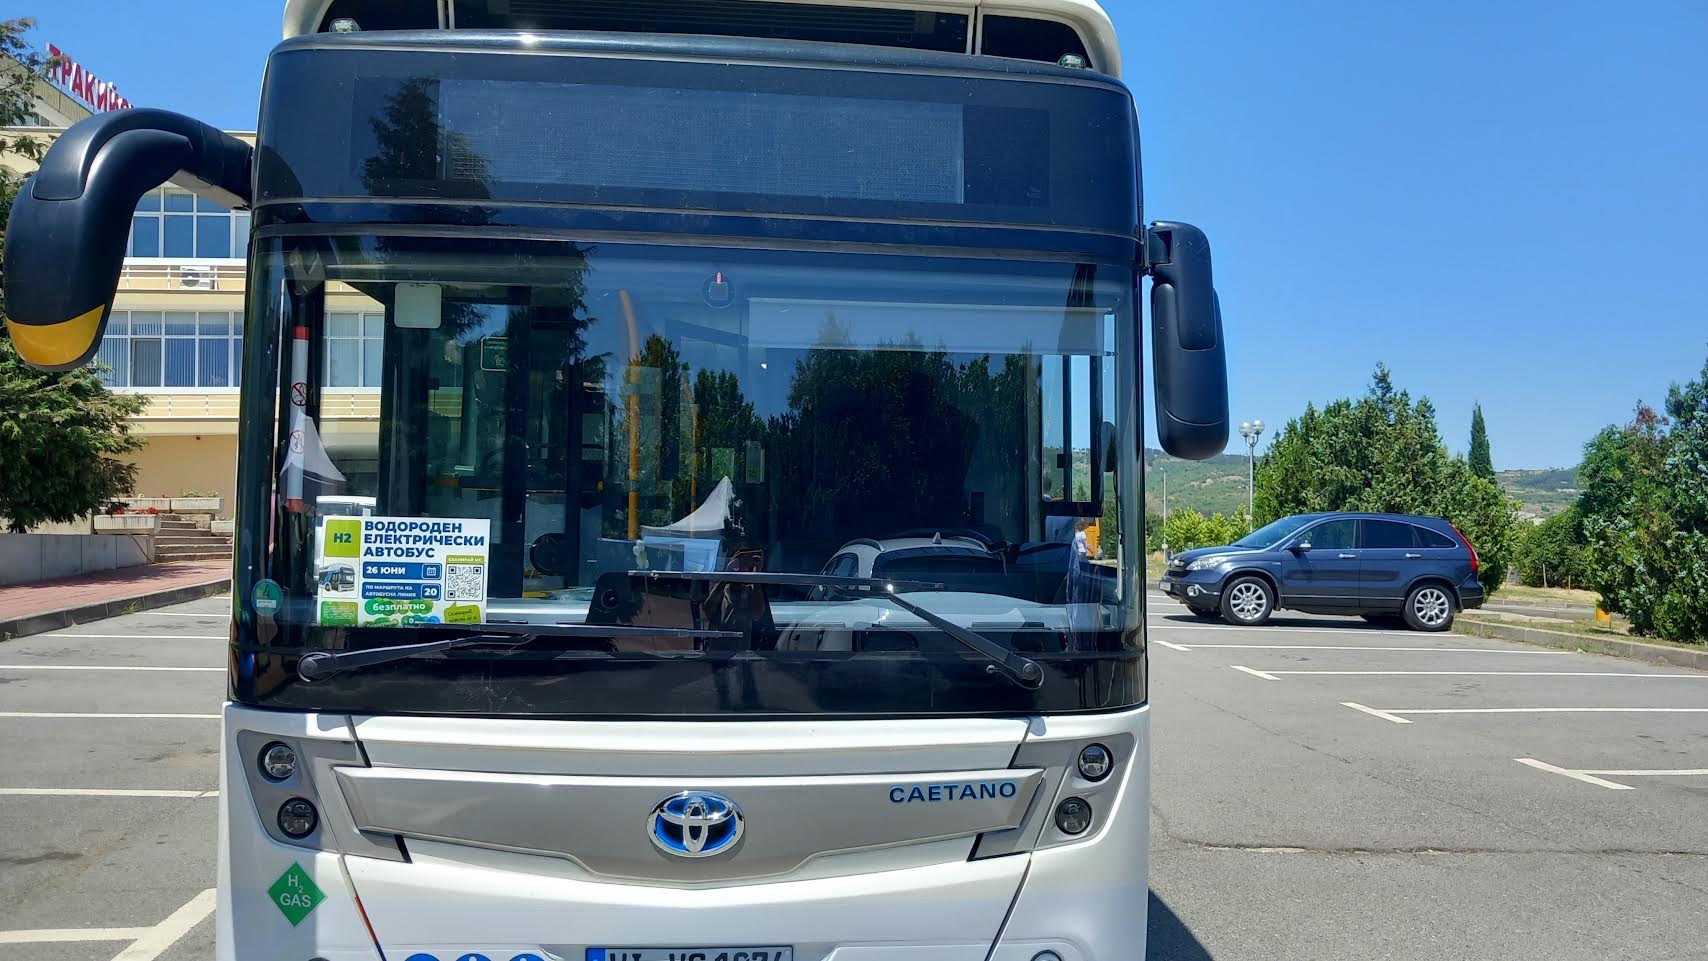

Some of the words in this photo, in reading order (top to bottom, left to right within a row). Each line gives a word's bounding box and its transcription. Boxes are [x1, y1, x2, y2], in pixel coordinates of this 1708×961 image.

[46, 43, 133, 112] ТРАКИЙ
[364, 520, 462, 534] ВОДОРОДЕН
[333, 532, 352, 544] H2
[364, 534, 485, 546] ЕЛЕКТРИЧЕСКИ
[363, 546, 435, 558] АВТОБУС
[366, 566, 379, 575] 26
[380, 566, 406, 575] ЮНИ
[262, 584, 271, 599] 4
[424, 587, 438, 596] 20
[372, 602, 426, 611] безплатно
[889, 781, 1016, 803] CAETANO
[280, 892, 312, 908] GAS
